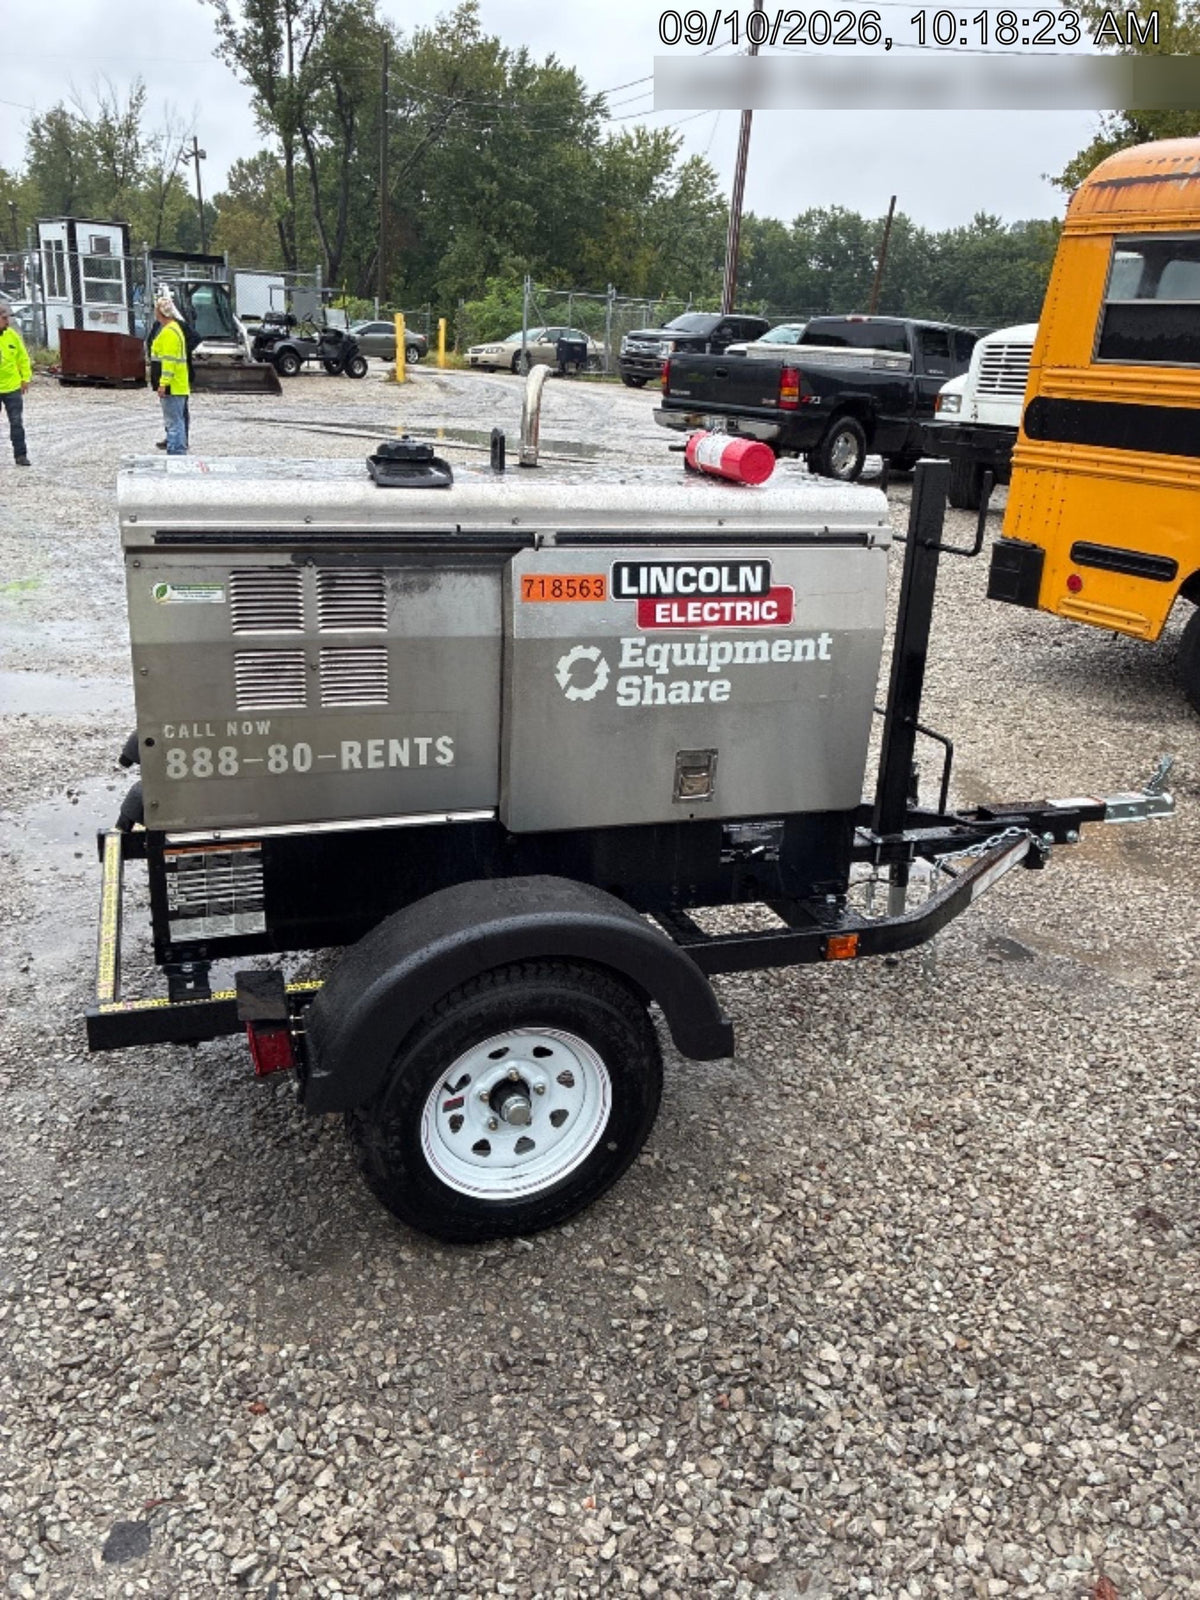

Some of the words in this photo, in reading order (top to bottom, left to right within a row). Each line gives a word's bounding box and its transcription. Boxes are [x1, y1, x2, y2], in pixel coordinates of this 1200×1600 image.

[523, 577, 605, 599] 718563
[620, 565, 763, 595] LINCOLN
[654, 600, 779, 624] ELECTRIC
[619, 633, 833, 672] Equipment
[616, 675, 731, 707] Share
[163, 722, 216, 739] CALL
[226, 719, 272, 737] NOW
[165, 735, 456, 780] 888-80-RENTS
